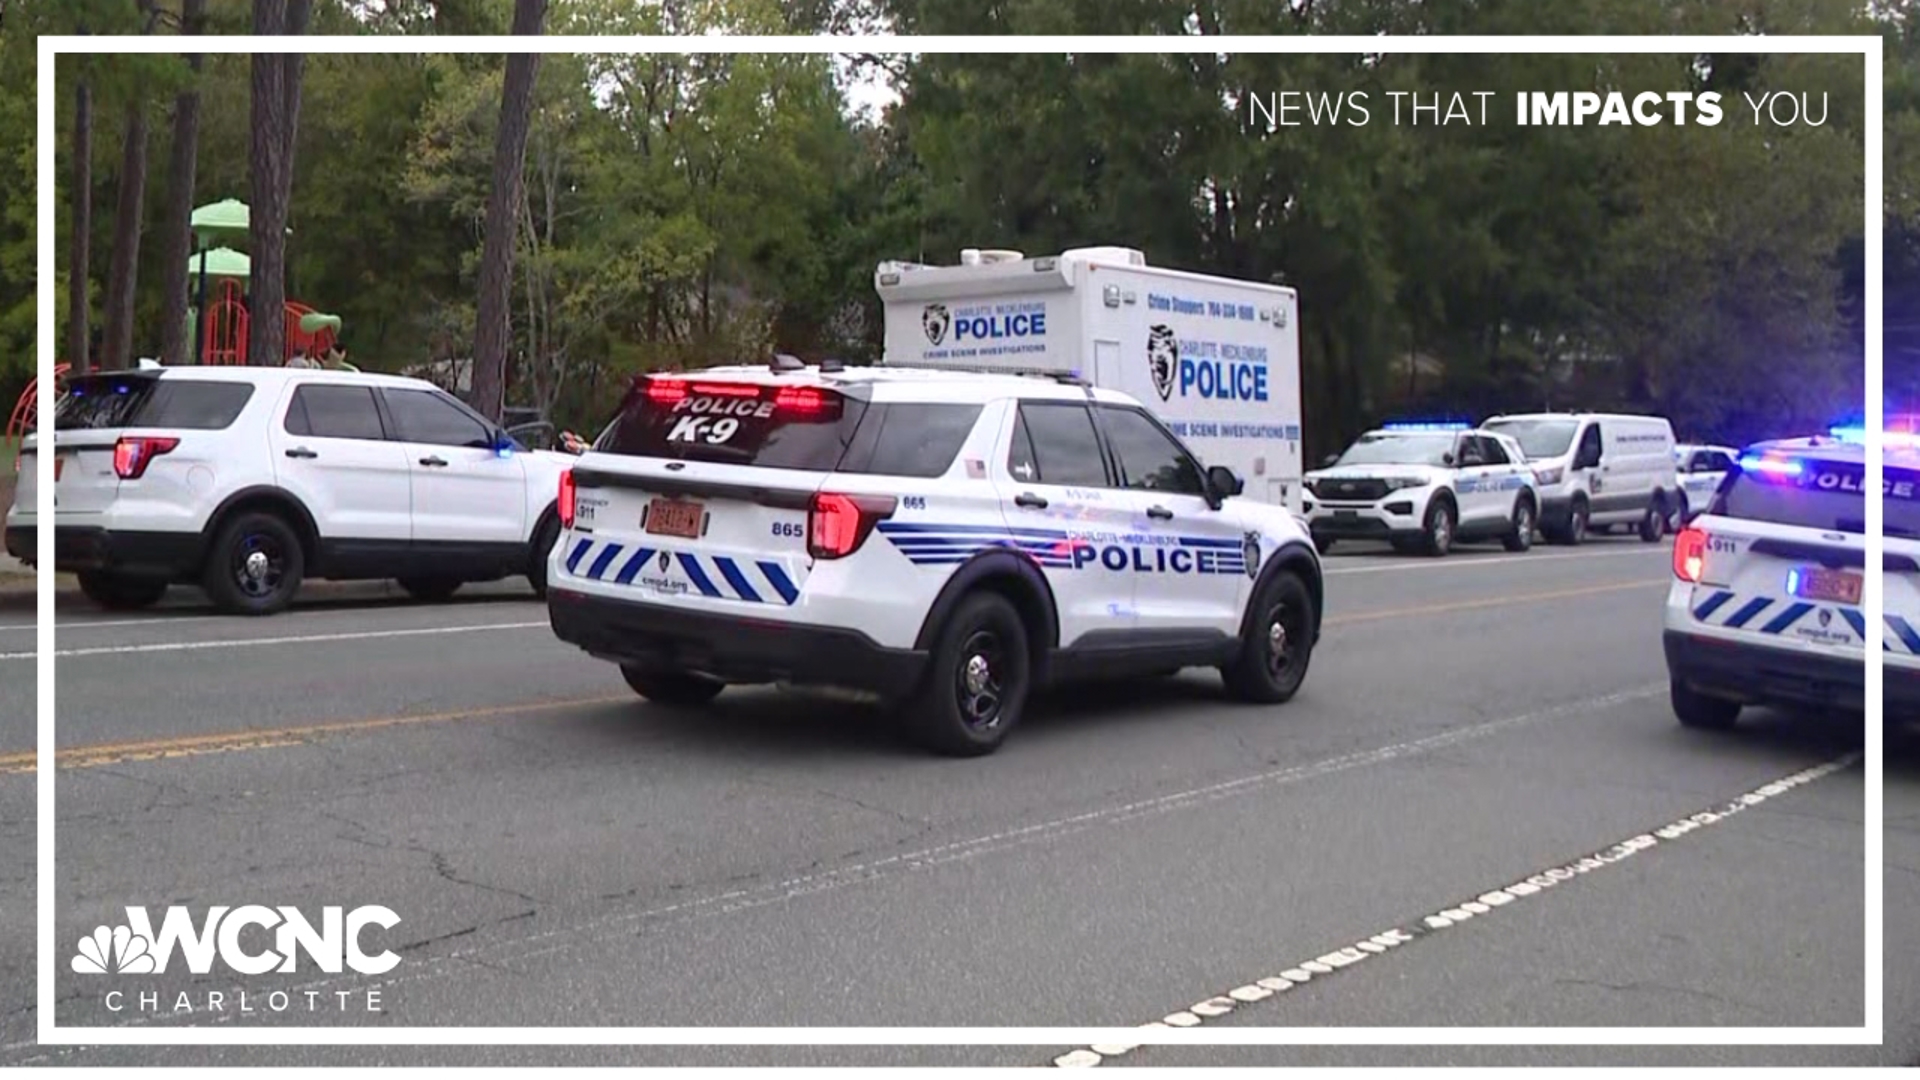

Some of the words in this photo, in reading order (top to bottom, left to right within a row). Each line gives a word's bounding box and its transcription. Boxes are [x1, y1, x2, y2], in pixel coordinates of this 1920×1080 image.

[955, 313, 1046, 341] POLICE
[979, 344, 1046, 356] INVESTIGATIONS
[1180, 359, 1269, 402] POLICE
[672, 397, 777, 418] POLICE
[666, 415, 739, 444] K-9
[1190, 422, 1218, 437] SCENE
[1220, 424, 1284, 439] INVESTIGATIONS
[771, 521, 804, 538] 865
[1714, 539, 1736, 554] 911
[1073, 544, 1215, 574] POLICE
[642, 576, 688, 593] cmpd.org
[1796, 627, 1851, 643] cmpd.org
